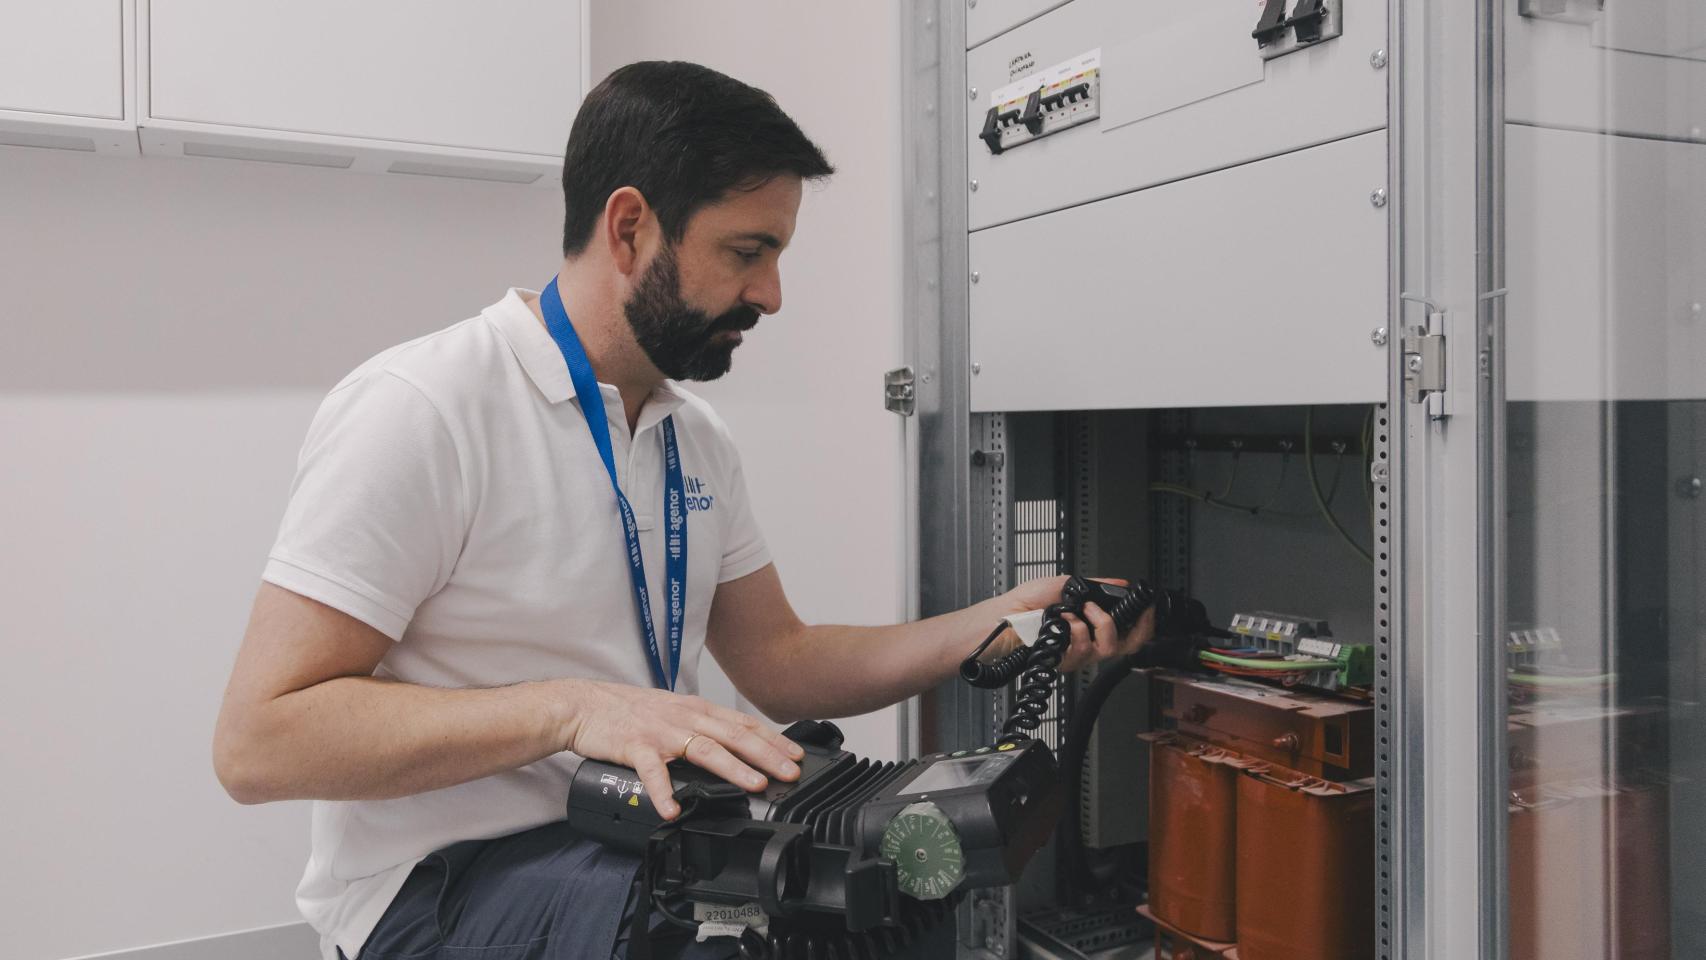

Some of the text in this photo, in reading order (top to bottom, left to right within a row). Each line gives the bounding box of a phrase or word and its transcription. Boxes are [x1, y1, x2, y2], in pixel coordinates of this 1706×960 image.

[620, 497, 637, 539] agenor
[670, 488, 683, 530] agenor
[686, 495, 714, 511] enor
[639, 586, 652, 629] agenor
[671, 578, 682, 623] agenor
[705, 907, 760, 920] 22010488
